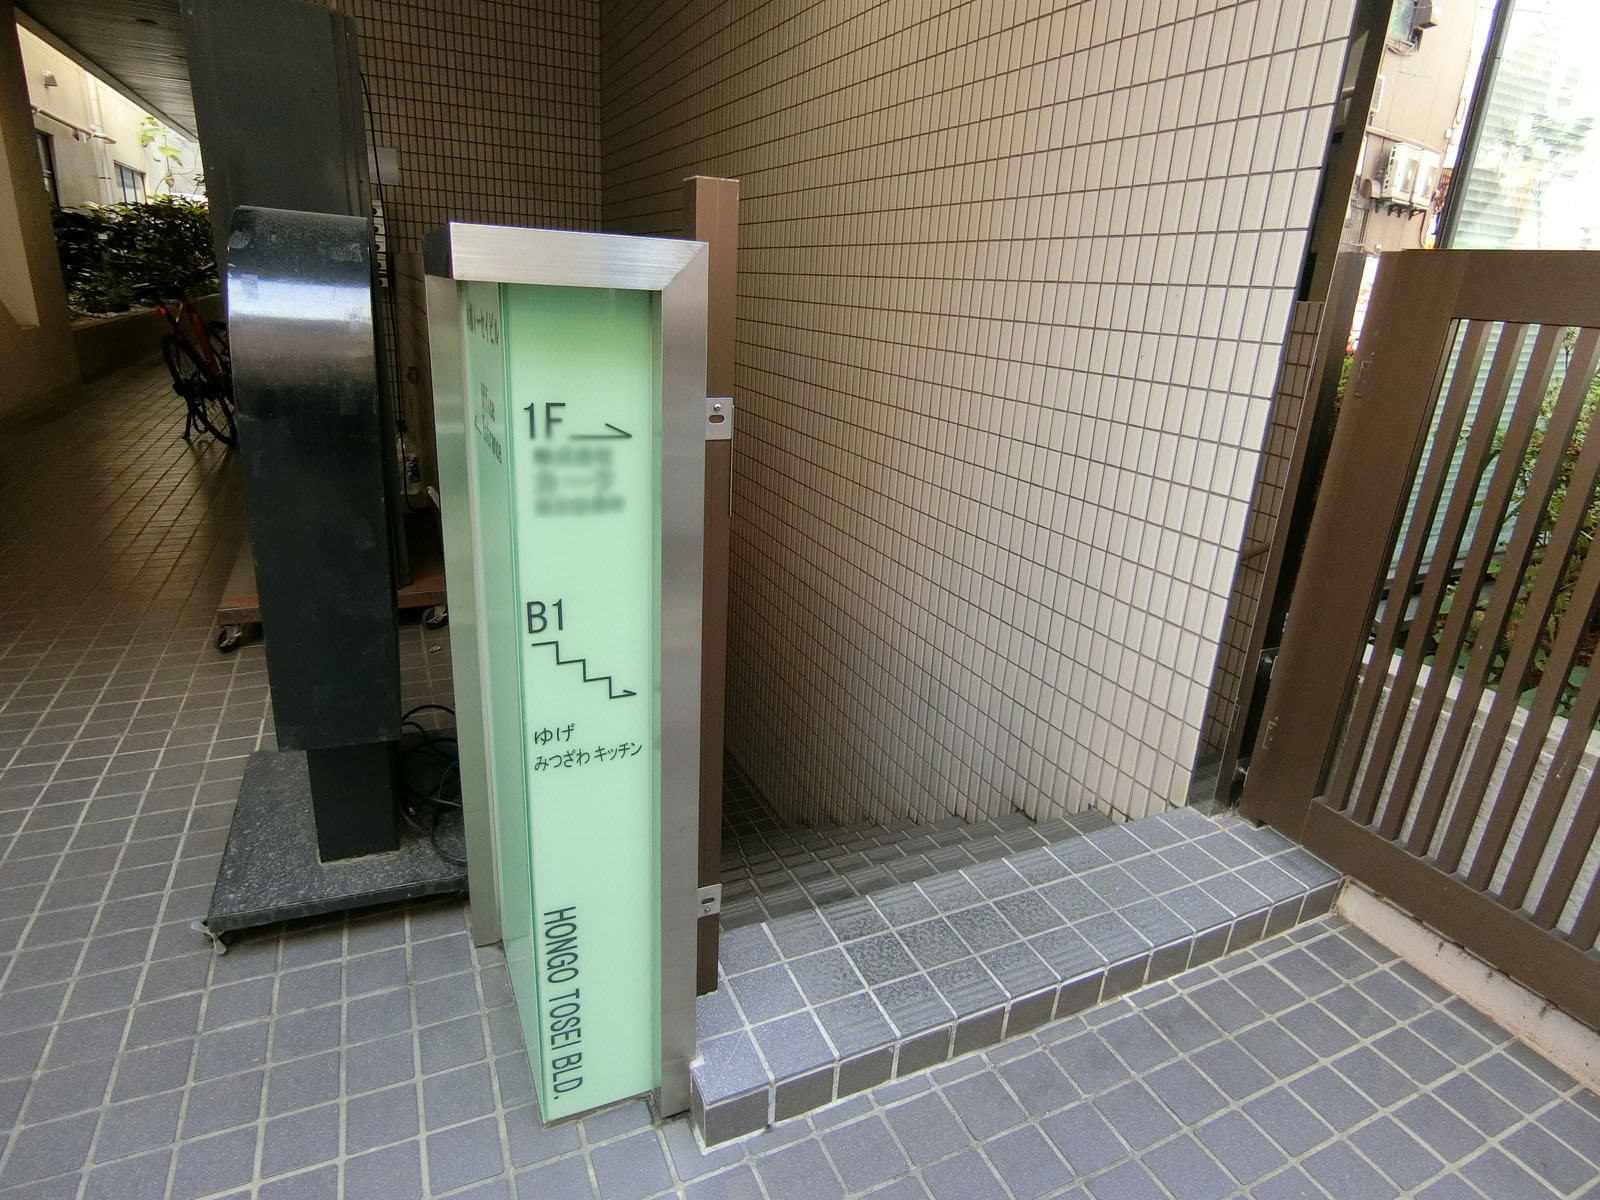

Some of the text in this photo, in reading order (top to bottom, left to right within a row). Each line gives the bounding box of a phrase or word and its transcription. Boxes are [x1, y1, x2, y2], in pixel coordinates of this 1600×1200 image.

[523, 402, 566, 440] 1F
[527, 599, 563, 634] B1
[534, 723, 576, 746] ゆげ
[543, 906, 583, 1100] HONGO TOSEI BLD.
